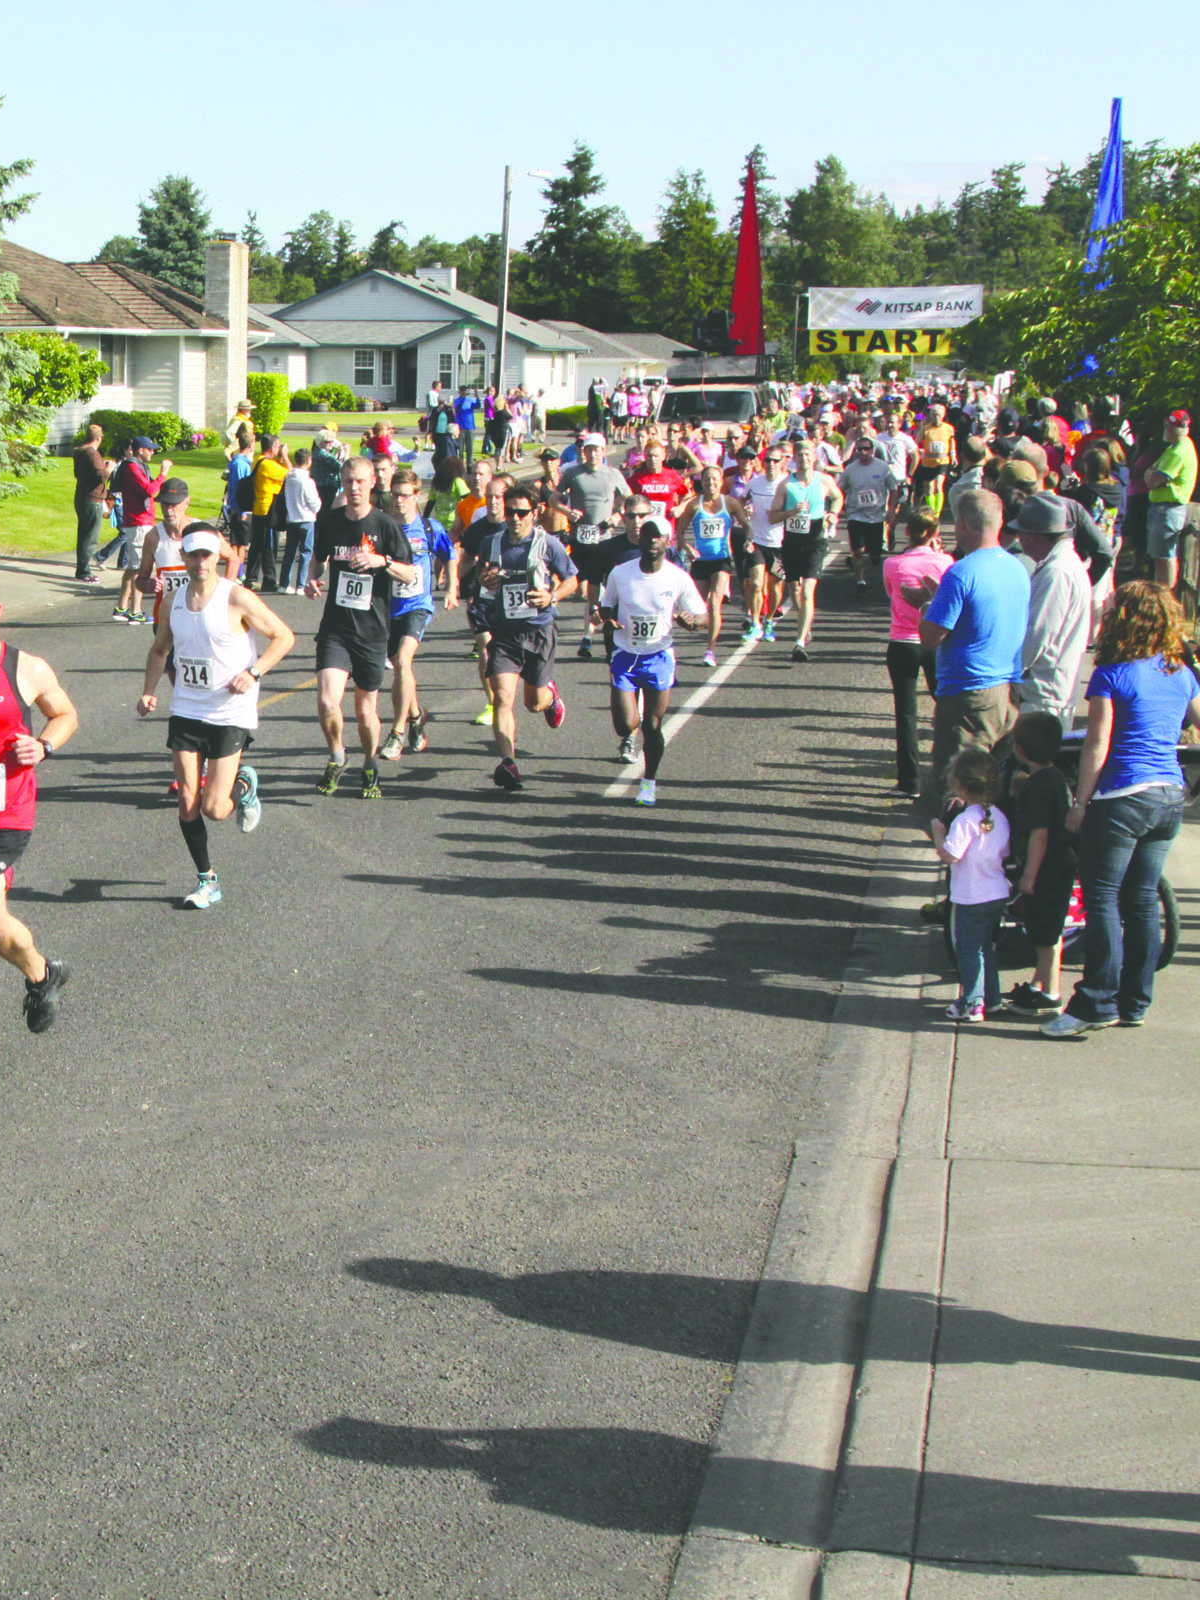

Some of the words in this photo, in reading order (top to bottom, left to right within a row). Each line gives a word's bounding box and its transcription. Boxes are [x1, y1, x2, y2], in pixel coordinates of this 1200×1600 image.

[884, 302, 932, 314] KITSAP
[935, 300, 974, 312] BANK
[816, 329, 945, 354] START
[641, 484, 669, 494] POLSKA
[788, 518, 807, 530] 202
[346, 580, 363, 597] 60
[632, 620, 657, 637] 387
[182, 664, 208, 685] 214
